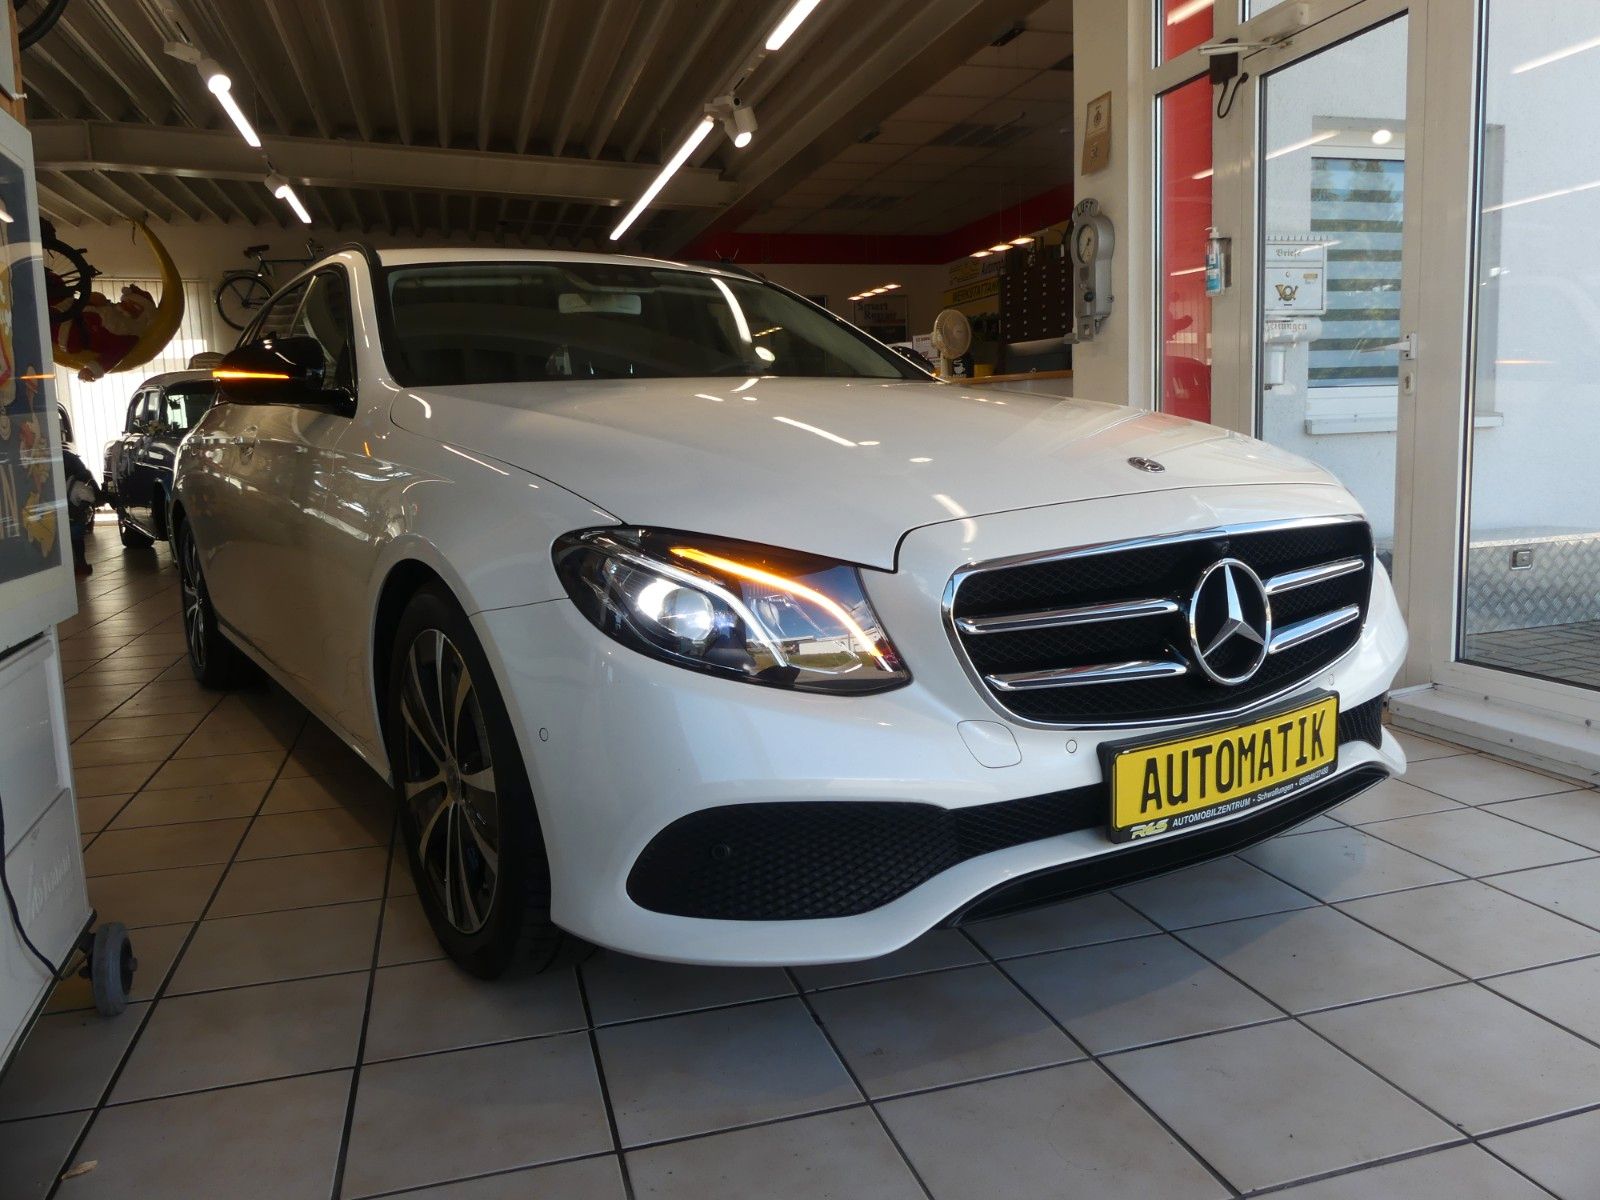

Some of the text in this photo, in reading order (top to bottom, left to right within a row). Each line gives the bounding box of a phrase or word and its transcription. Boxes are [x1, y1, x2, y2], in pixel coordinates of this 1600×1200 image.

[1076, 200, 1096, 217] LUFT
[1140, 709, 1326, 813] AUTOMATIK
[1173, 797, 1251, 828] AUTOMOBILZENTRUM
